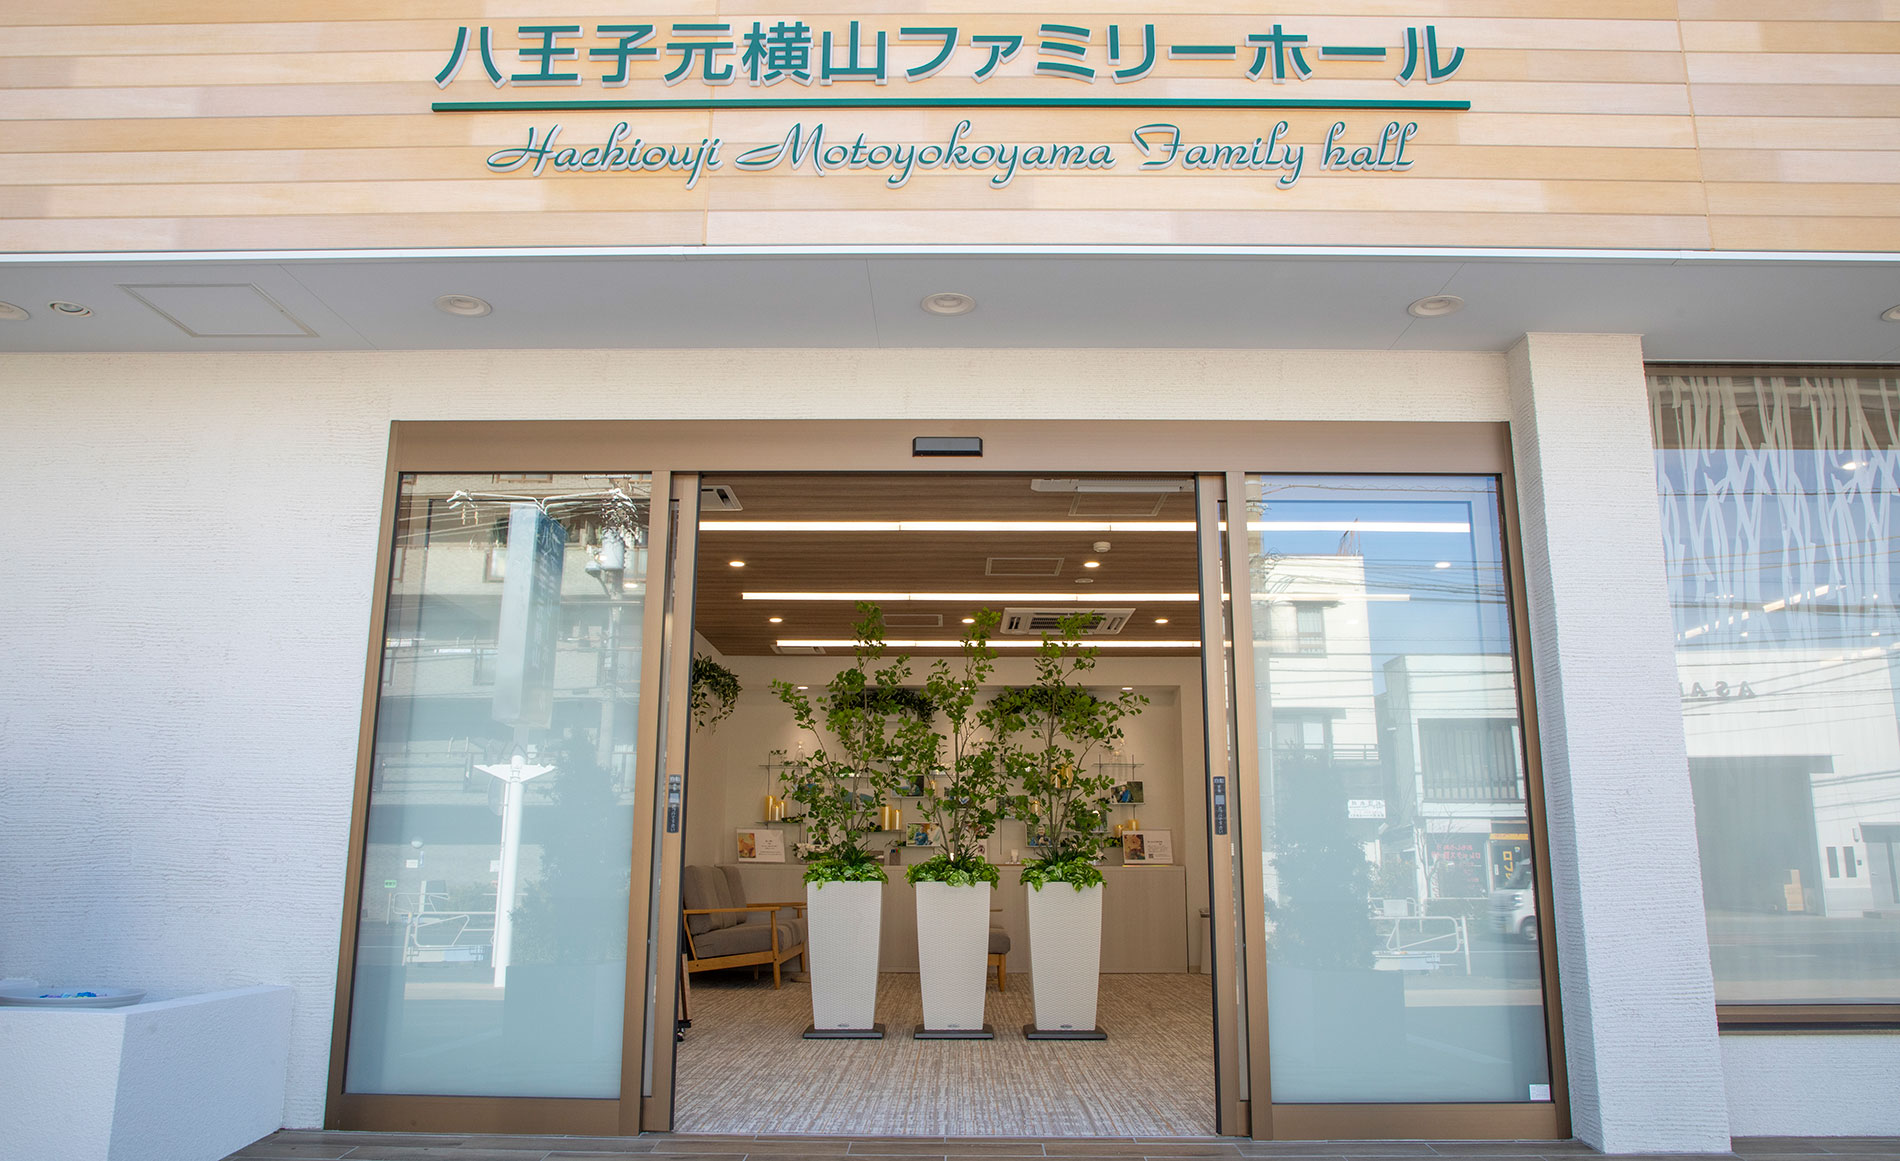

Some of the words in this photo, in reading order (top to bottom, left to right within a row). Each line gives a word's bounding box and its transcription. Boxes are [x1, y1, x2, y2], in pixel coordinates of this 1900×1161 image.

[434, 21, 1466, 88] 八王子元横山ファミリーホール
[486, 121, 723, 190] Hachiouji
[735, 119, 1116, 189] Motoyokoyama
[1131, 120, 1304, 189] Family
[1320, 121, 1419, 172] hall
